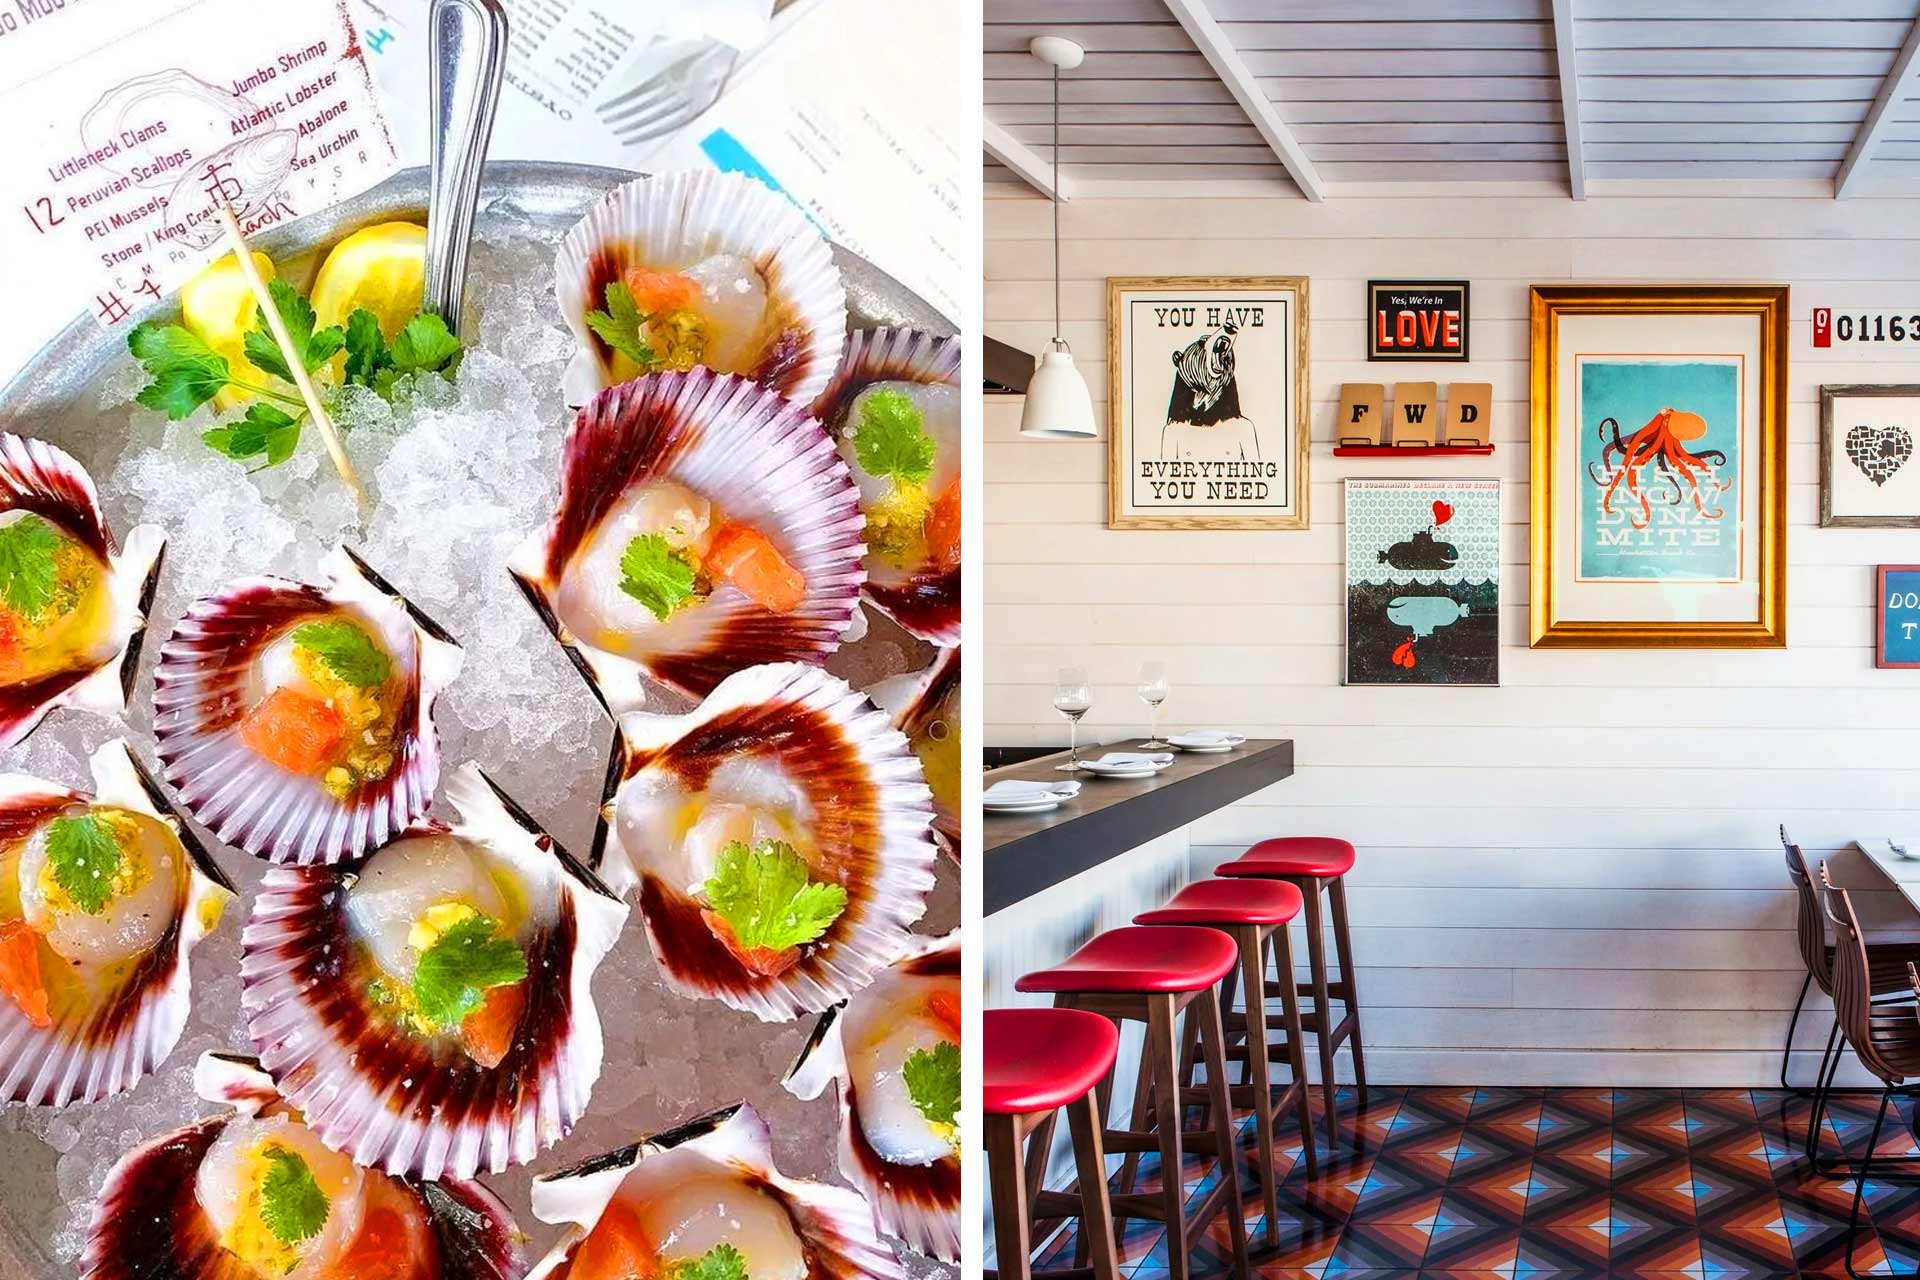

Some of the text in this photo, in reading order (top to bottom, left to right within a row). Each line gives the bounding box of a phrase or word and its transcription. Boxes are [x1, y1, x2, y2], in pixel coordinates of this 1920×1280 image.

[233, 41, 328, 97] Jumbo Shrimp
[231, 70, 337, 136] Atlantic Lobster
[299, 100, 348, 137] Abalone
[49, 121, 167, 183] Littleneck Clams
[290, 128, 359, 171] Sea Urchin
[67, 148, 192, 213] Peruvian Scallops
[24, 197, 65, 234] 12
[84, 195, 169, 241] PEI Mussels
[101, 242, 143, 268] Stone
[153, 222, 187, 243] King
[1154, 308, 1264, 327] YOU HAVE
[1391, 296, 1407, 306] Yes,
[1409, 296, 1433, 305] We're
[1378, 310, 1460, 347] LOVE
[1351, 404, 1478, 423] F W D
[1141, 462, 1278, 478] EVERYTHING
[1150, 482, 1269, 499] YOU NEED
[1596, 528, 1720, 546] MITE
[1888, 592, 1920, 609] DO
